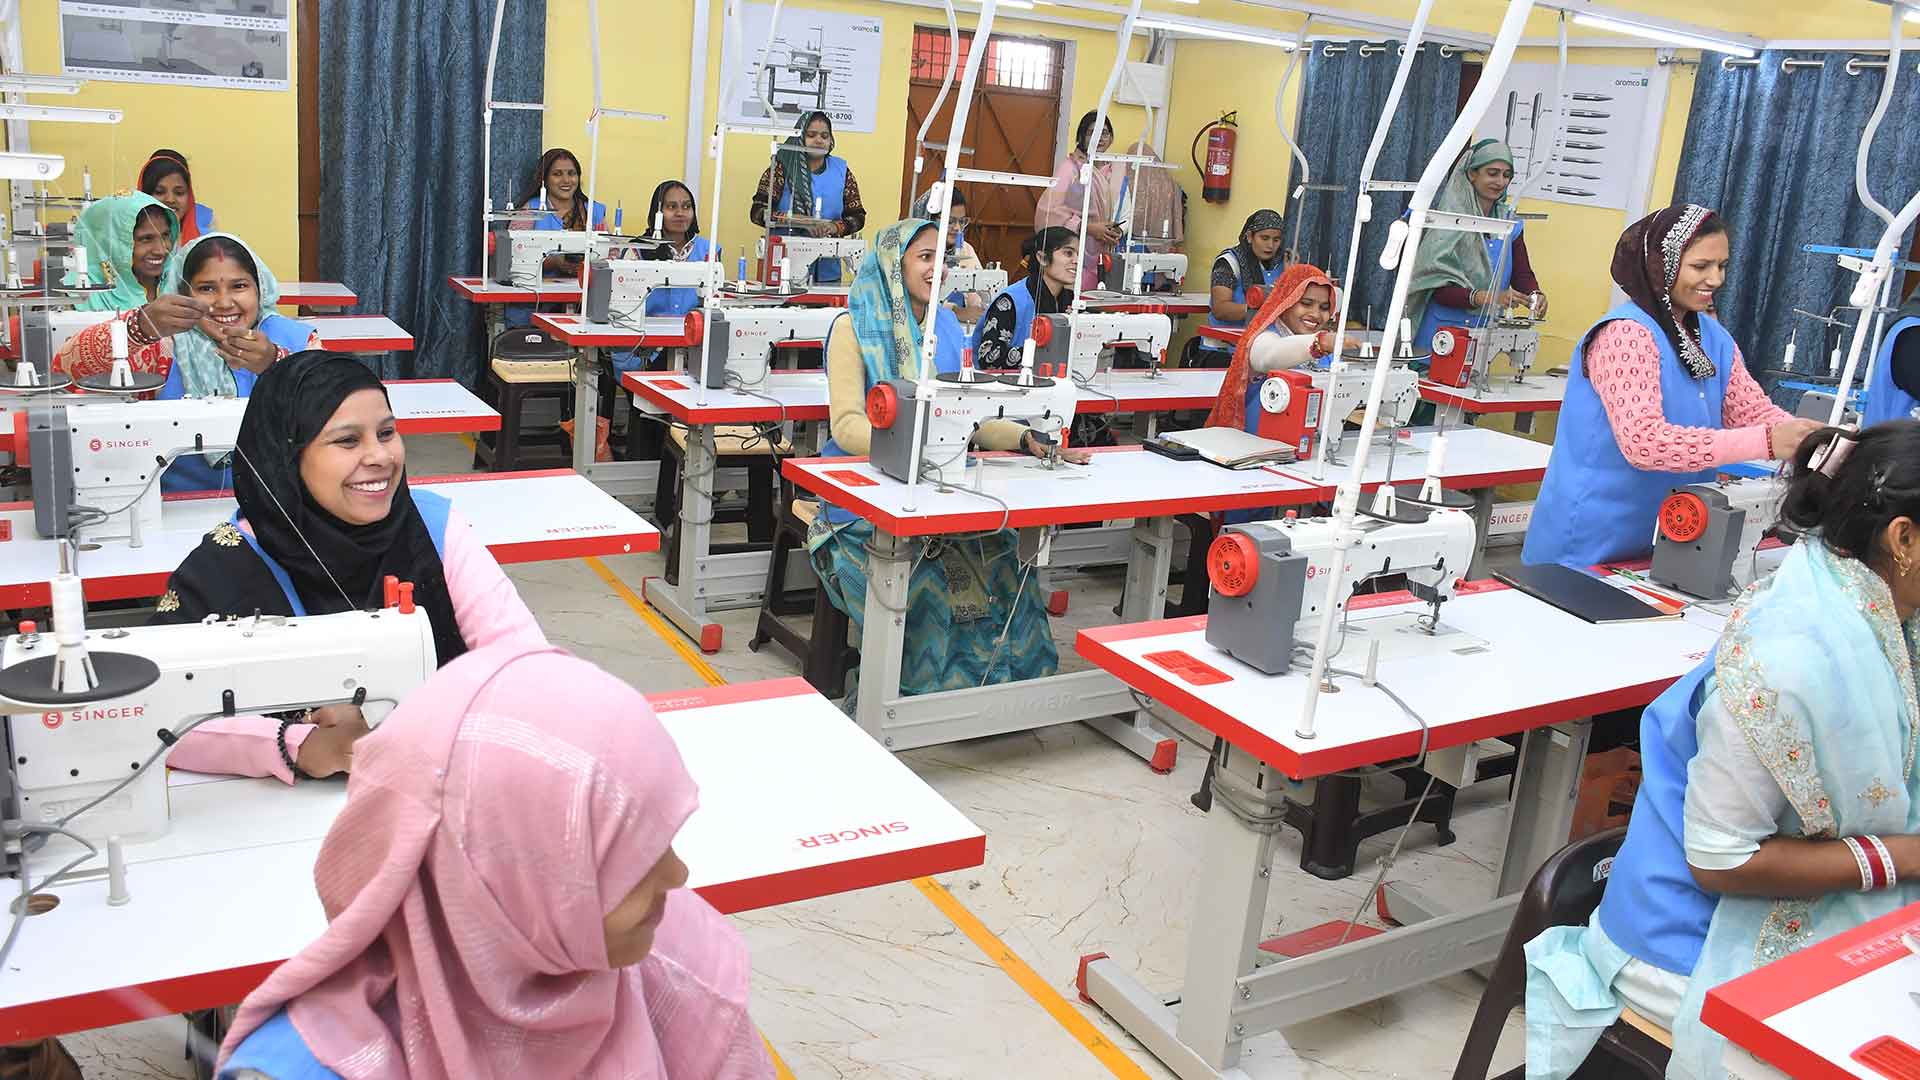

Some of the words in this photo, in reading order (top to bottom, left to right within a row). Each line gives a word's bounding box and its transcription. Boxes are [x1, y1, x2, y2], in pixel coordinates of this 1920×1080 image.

[1615, 79, 1640, 87] aramco
[945, 408, 971, 416] SINGER
[106, 440, 149, 448] SINGER
[1490, 513, 1529, 525] SINGER
[72, 706, 144, 721] SINGER
[796, 821, 909, 848] SINGER
